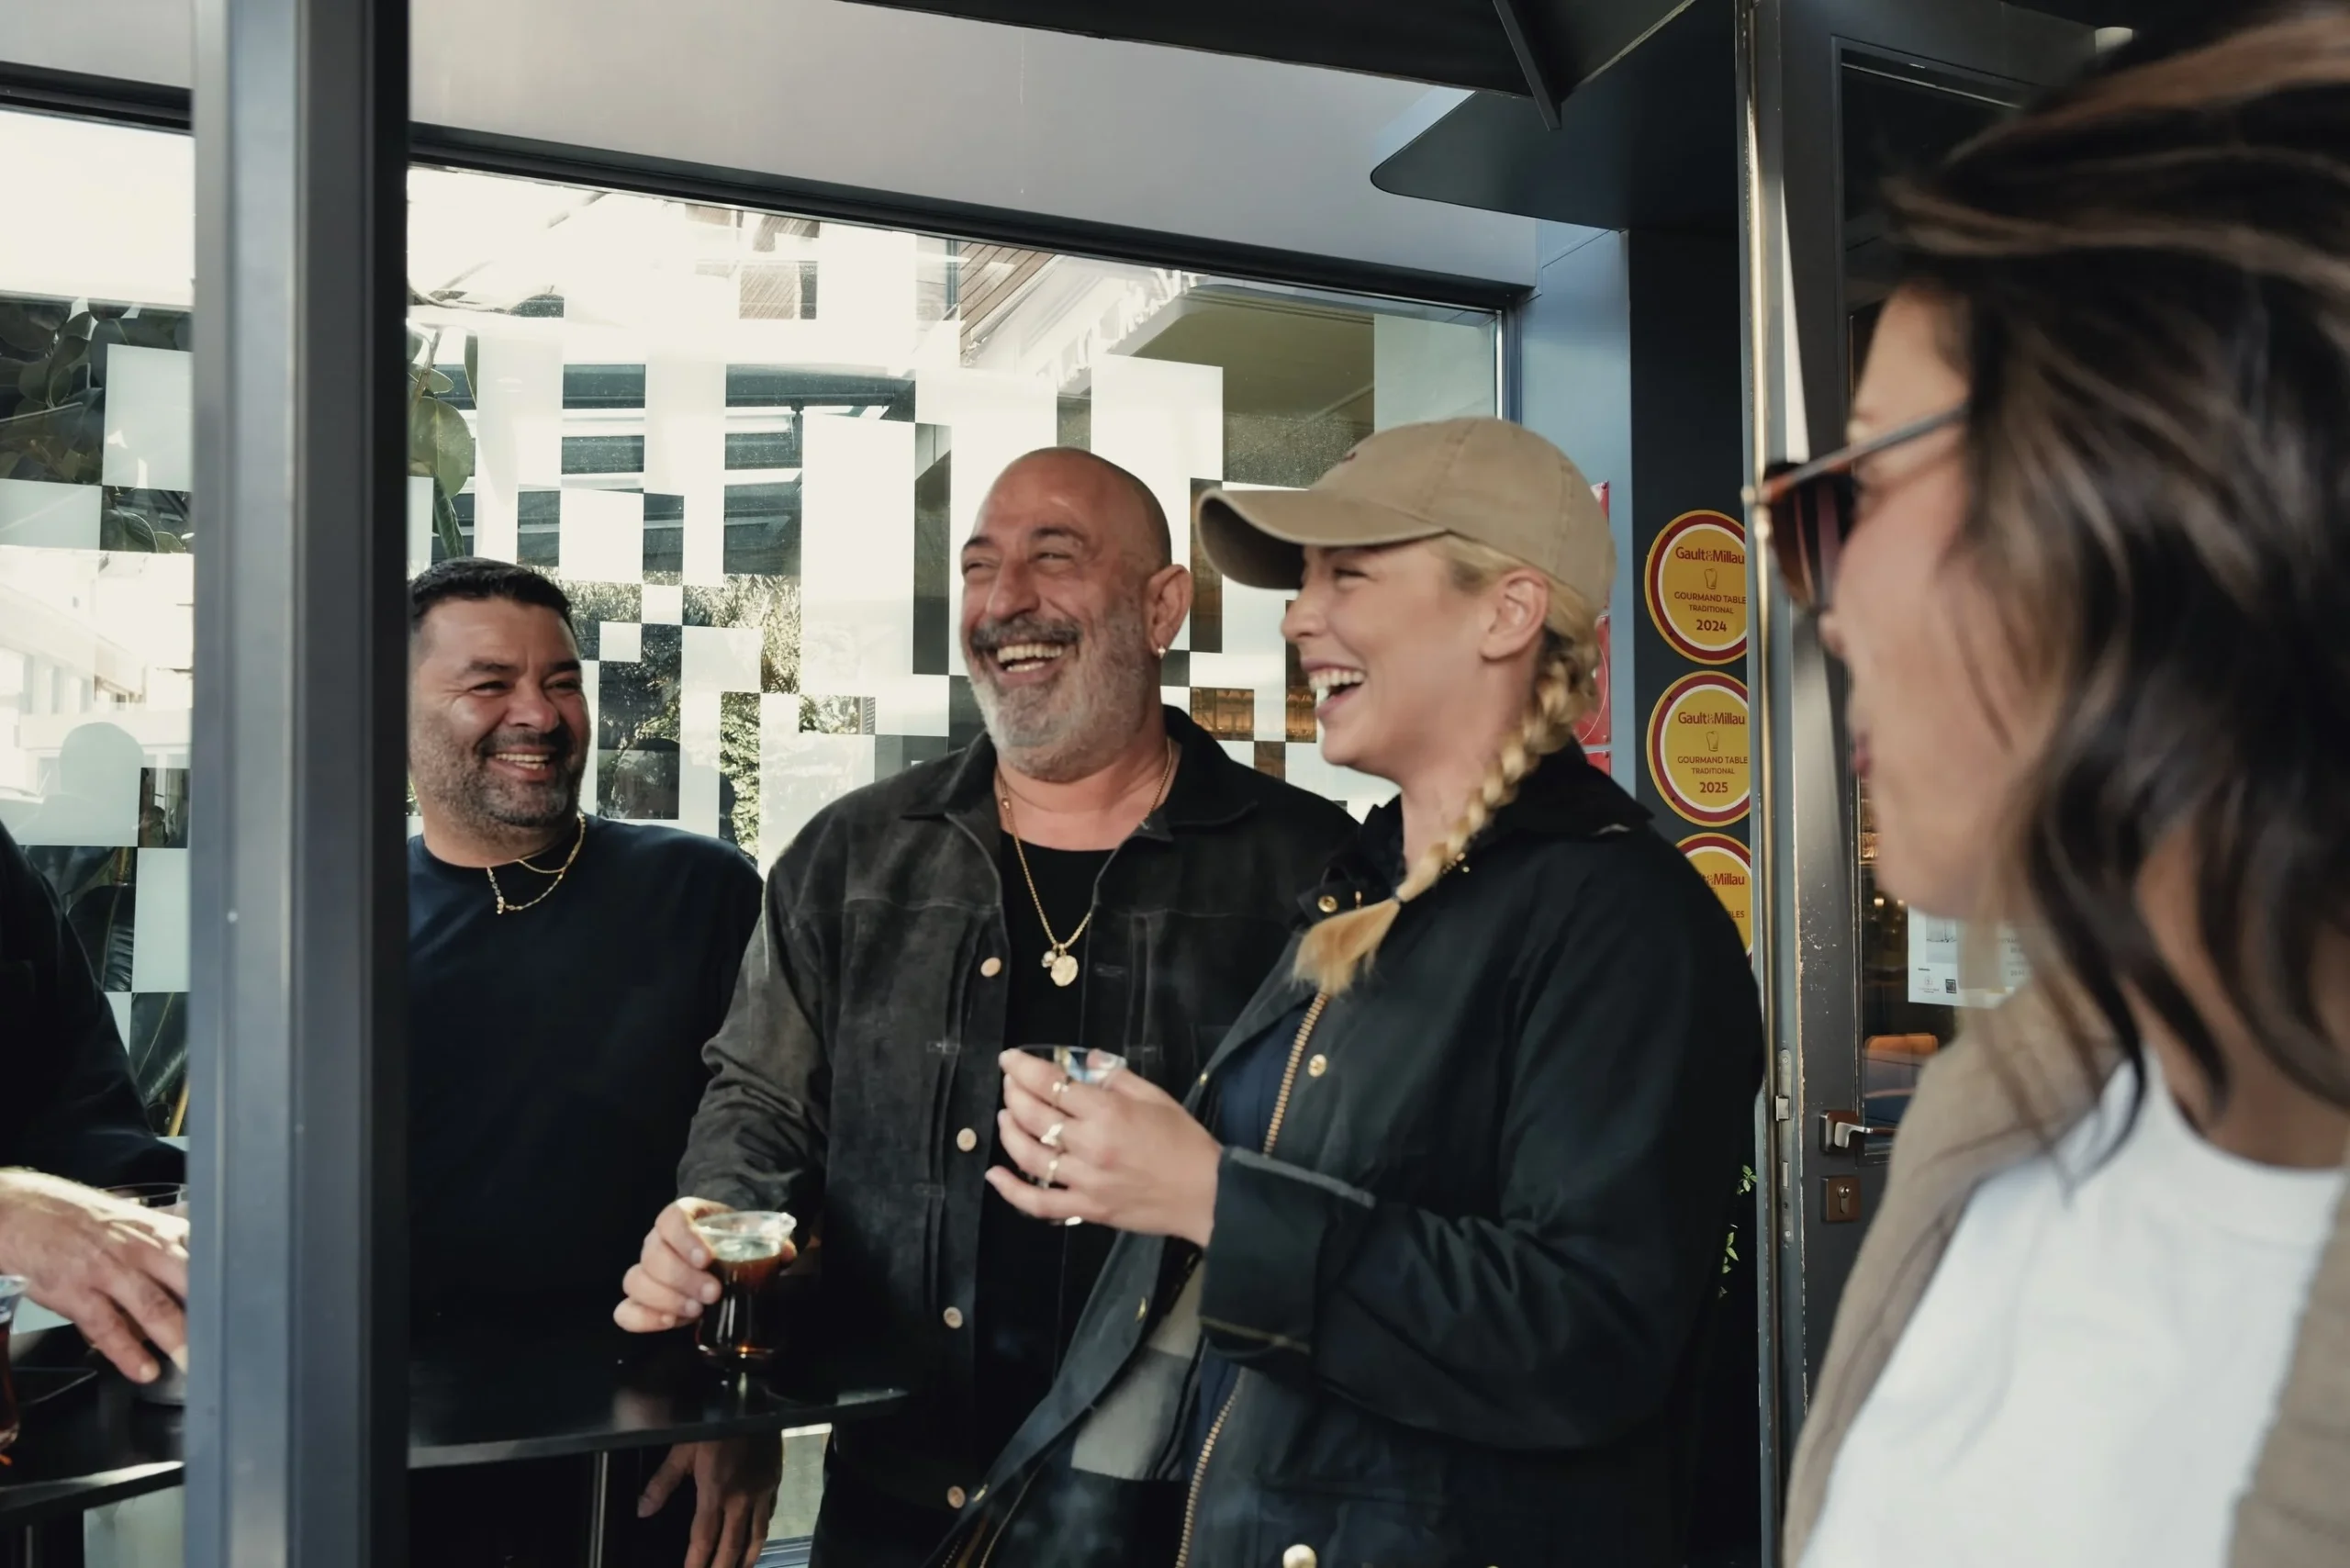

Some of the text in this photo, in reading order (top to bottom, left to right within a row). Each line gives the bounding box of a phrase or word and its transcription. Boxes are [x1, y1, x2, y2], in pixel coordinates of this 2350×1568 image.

[1675, 546, 1745, 565] Gault&Millau
[1674, 591, 1746, 604] GOURMAND TABLE
[1689, 604, 1734, 613] TRADITIONAL
[1696, 620, 1727, 632] 2024
[1678, 711, 1745, 725] Gault&Millau
[1677, 756, 1748, 764] GOURMAND TABLE
[1699, 781, 1729, 793] 2025
